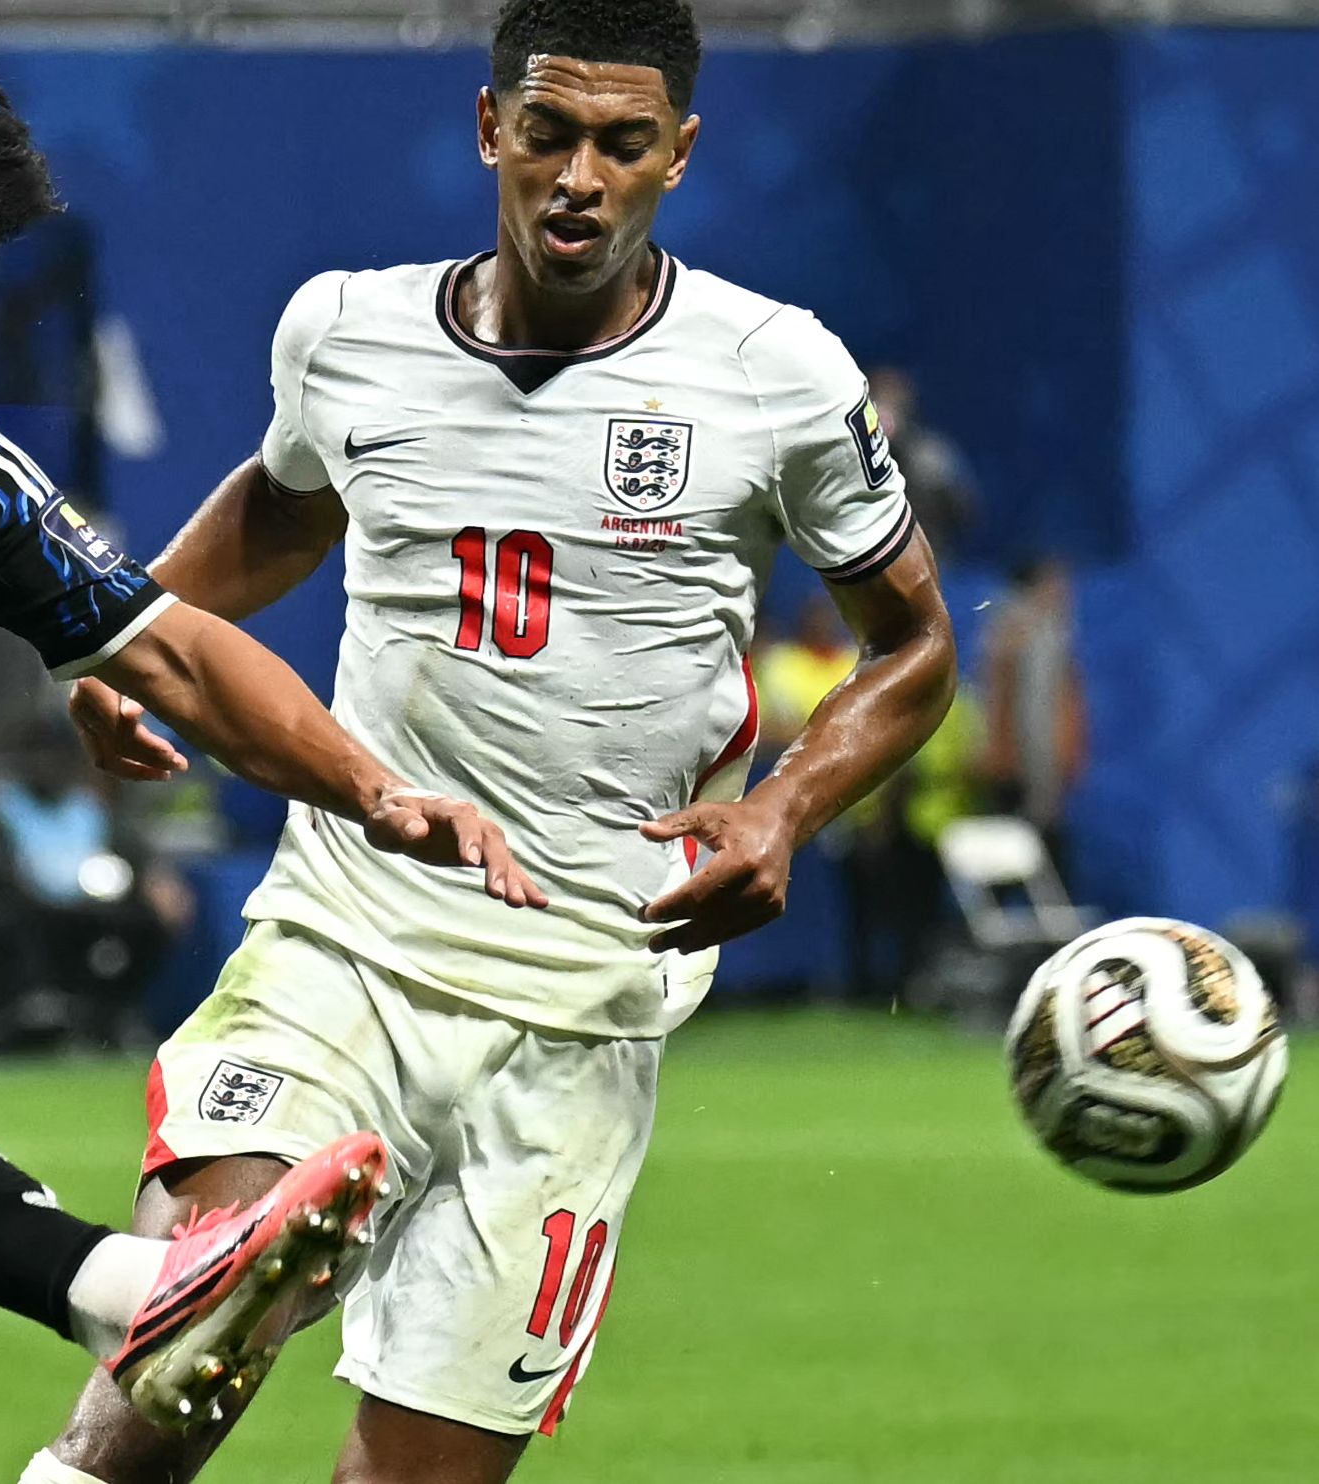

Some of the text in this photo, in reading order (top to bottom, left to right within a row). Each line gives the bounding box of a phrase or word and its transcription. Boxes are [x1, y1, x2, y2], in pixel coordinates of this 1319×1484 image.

[451, 526, 554, 659] 10
[600, 515, 683, 537] ARGENTINA
[526, 1208, 608, 1349] 10
